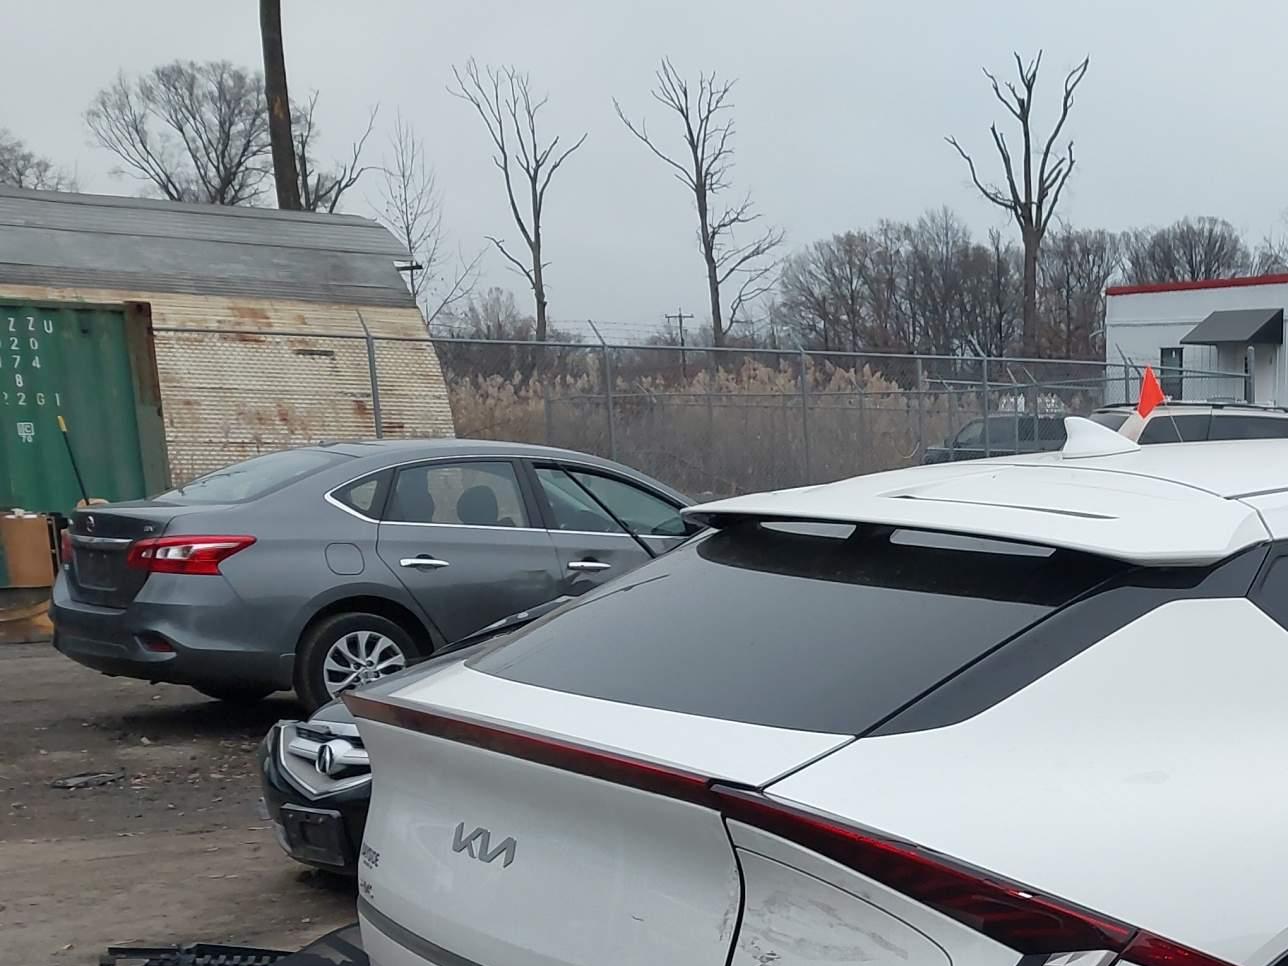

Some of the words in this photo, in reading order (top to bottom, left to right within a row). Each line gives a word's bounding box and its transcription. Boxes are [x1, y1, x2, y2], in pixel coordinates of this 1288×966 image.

[0, 336, 39, 351] 20
[15, 373, 24, 387] 8
[452, 821, 517, 869] KIA
